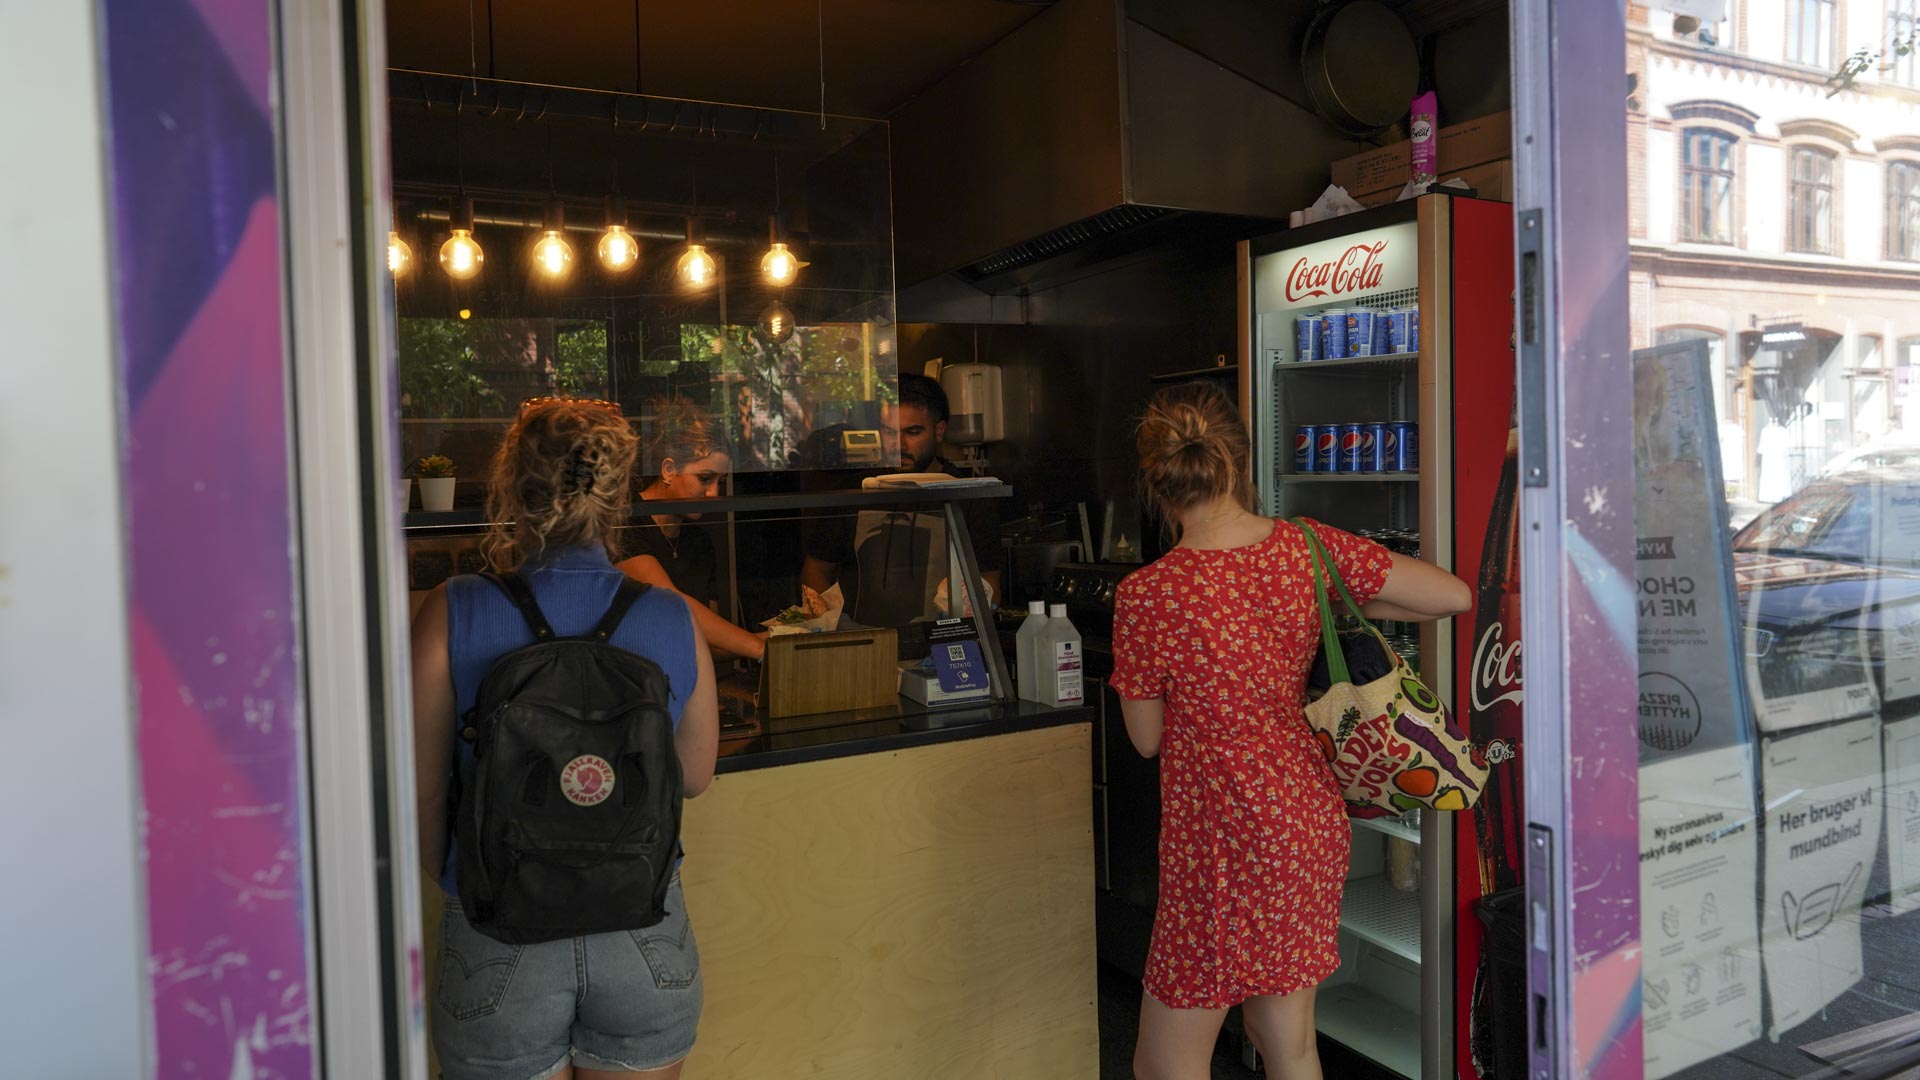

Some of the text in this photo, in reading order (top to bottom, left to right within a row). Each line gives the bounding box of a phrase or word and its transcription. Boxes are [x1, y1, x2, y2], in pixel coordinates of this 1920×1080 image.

[1285, 240, 1389, 303] Coca-Cola
[1358, 734, 1411, 799] JOE'S
[1780, 812, 1807, 834] Her
[1810, 797, 1857, 824] bruger
[1790, 818, 1861, 861] mundbind
